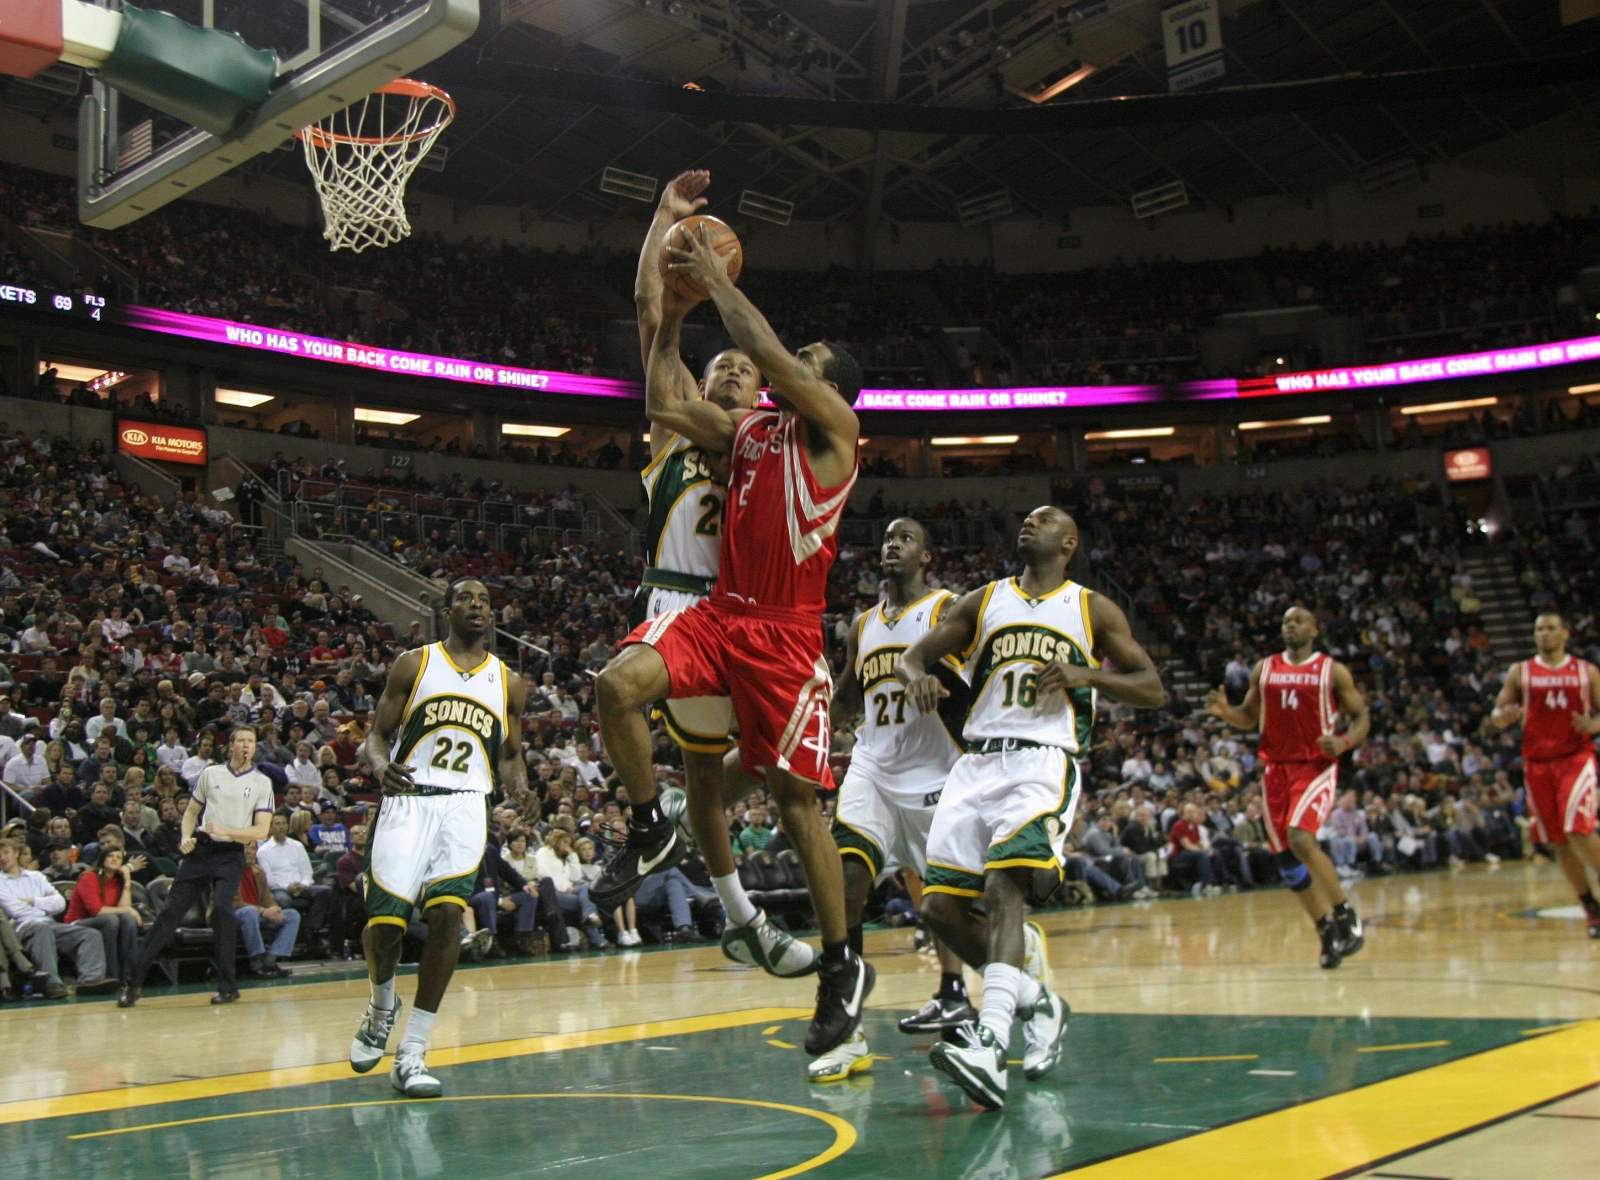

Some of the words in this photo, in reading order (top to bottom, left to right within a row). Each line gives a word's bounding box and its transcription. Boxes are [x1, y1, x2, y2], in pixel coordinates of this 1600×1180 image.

[1175, 20, 1207, 54] 10
[54, 295, 73, 311] 69
[84, 294, 105, 307] FLS
[91, 308, 101, 321] 4
[226, 326, 263, 345] WHO
[266, 333, 298, 351] HAS
[302, 340, 343, 359] YOUR
[347, 348, 386, 367] BACK
[390, 355, 431, 373] COME
[435, 361, 471, 378] RAIN
[473, 367, 494, 382] OR
[497, 370, 549, 388] SHINE?
[1276, 373, 1314, 391] WHO
[1315, 371, 1350, 388] HAS
[1352, 367, 1396, 384] YOUR
[1400, 361, 1444, 379] BACK
[1446, 356, 1493, 375] COME
[1494, 351, 1537, 369] RAIN
[1538, 346, 1564, 363] OR
[863, 394, 904, 407] BACK
[905, 394, 947, 407] COME
[949, 394, 987, 407] RAIN
[988, 393, 1011, 406] OR
[1013, 391, 1067, 405] SHINE?
[151, 436, 167, 446] KIA
[167, 438, 203, 450] MOTORS
[391, 455, 411, 467] 127
[694, 494, 726, 536] 2
[991, 632, 1071, 667] SONICS
[1002, 671, 1037, 710] 16
[1281, 689, 1299, 710] 14
[1545, 690, 1568, 710] 44
[424, 700, 493, 738] SONICS
[873, 690, 906, 727] 27
[430, 736, 473, 774] 22
